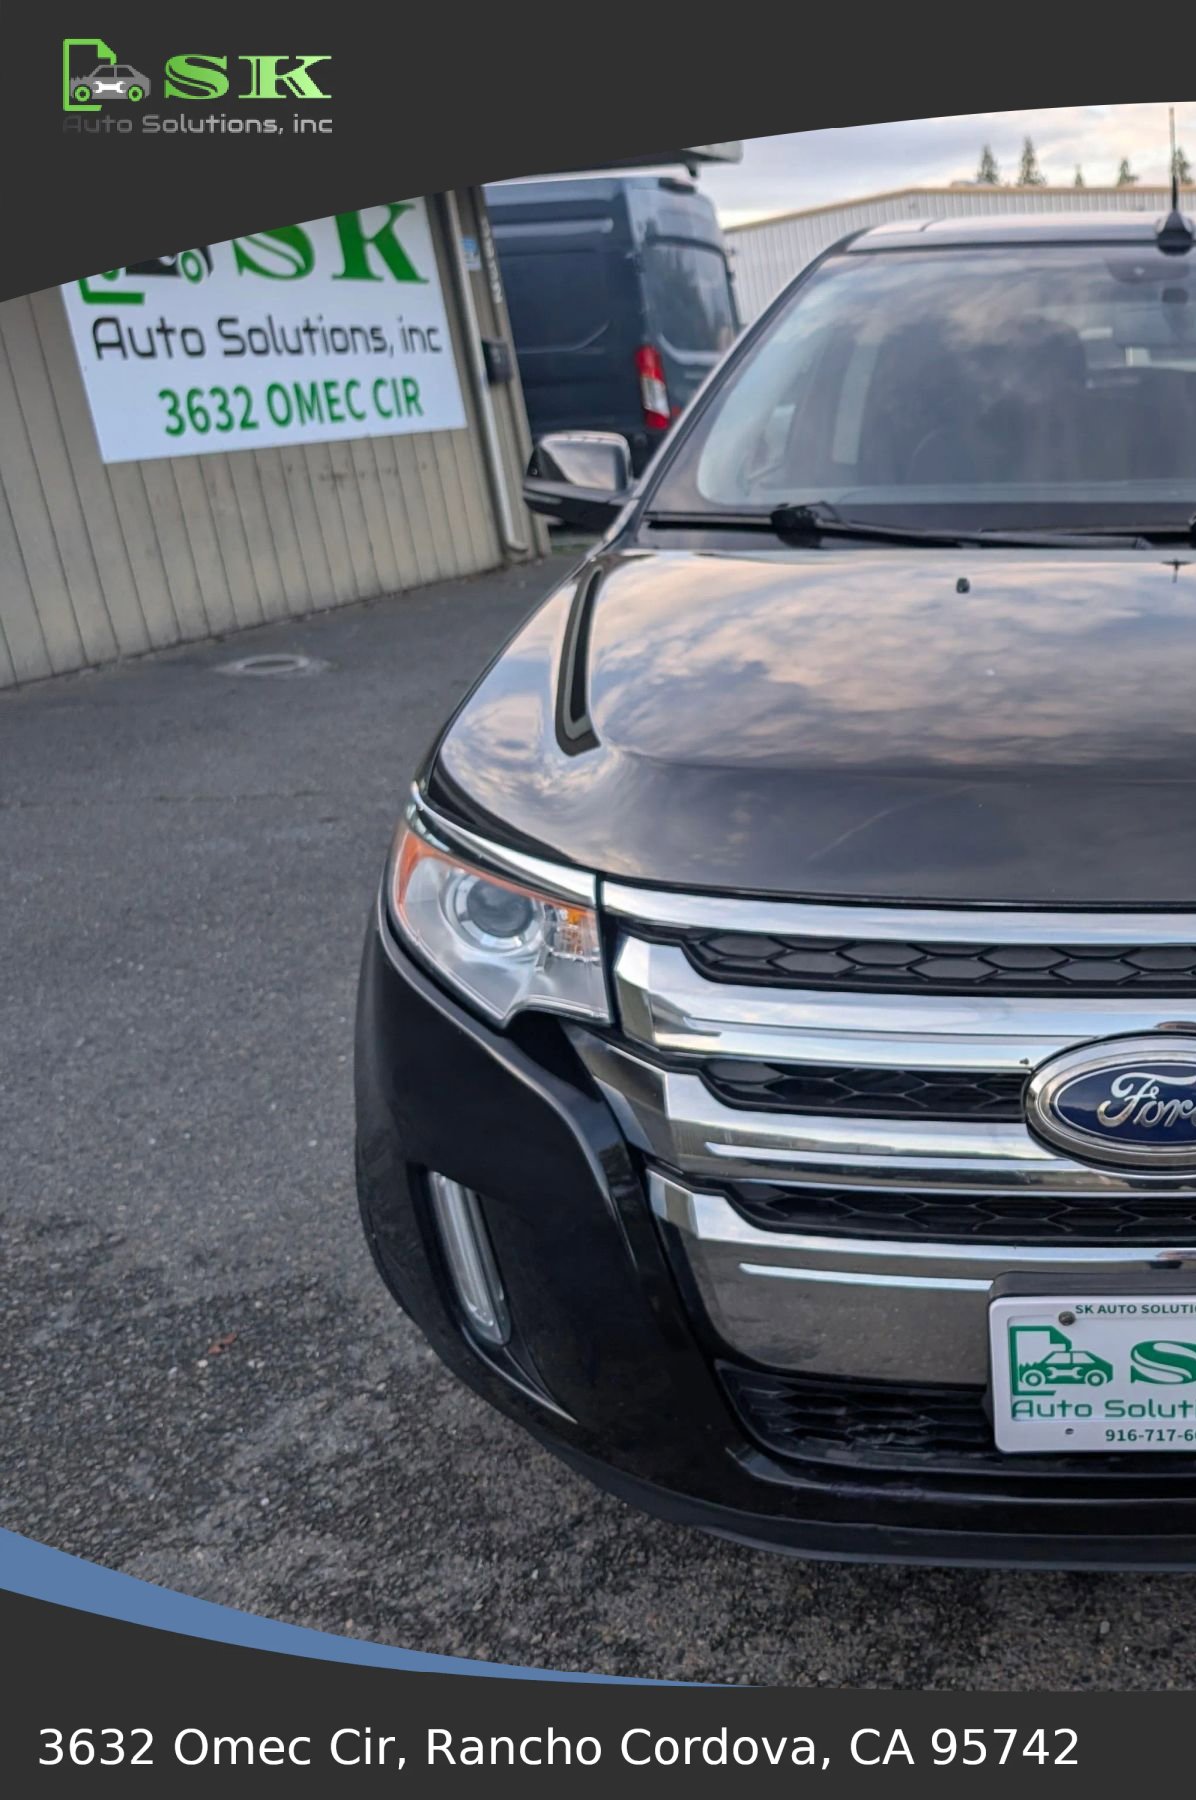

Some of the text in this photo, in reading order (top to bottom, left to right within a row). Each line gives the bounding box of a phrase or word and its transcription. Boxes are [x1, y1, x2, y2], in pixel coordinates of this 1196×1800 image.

[91, 313, 443, 361] Auto Solutions, inc
[157, 376, 425, 437] 3632 OMEC CIR
[1075, 1304, 1094, 1314] SK
[1097, 1304, 1138, 1314] AUTO
[1010, 1399, 1093, 1420] Auto
